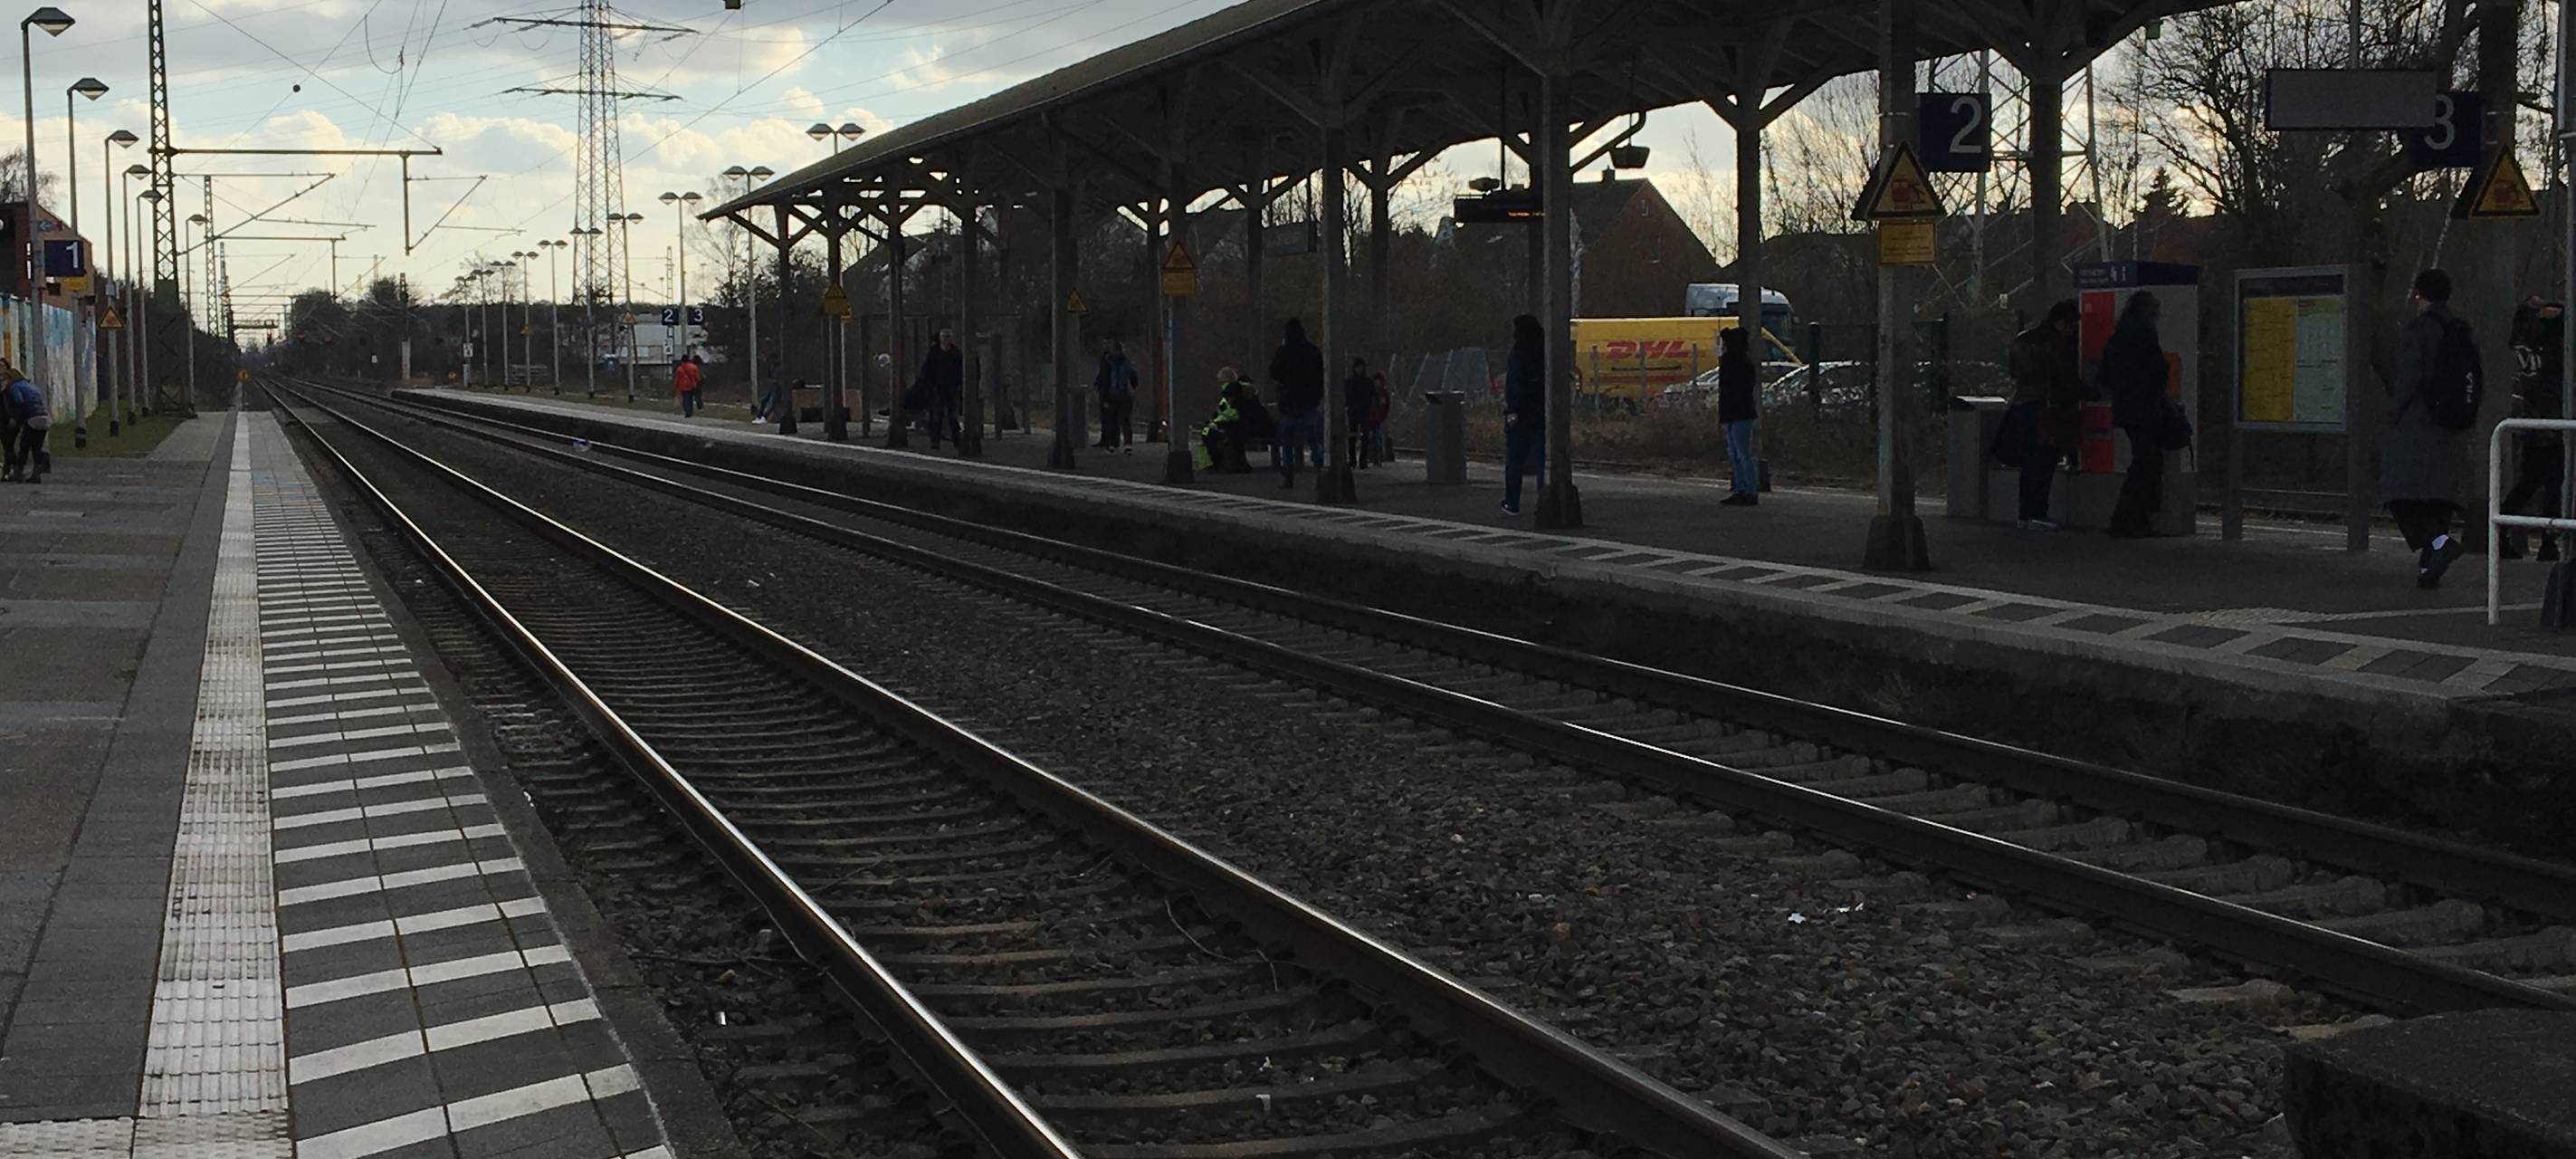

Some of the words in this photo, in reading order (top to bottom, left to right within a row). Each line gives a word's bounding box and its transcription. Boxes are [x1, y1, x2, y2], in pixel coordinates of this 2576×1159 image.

[1950, 97, 1982, 153] 2
[2424, 94, 2455, 150] 3
[66, 242, 78, 268] 1
[663, 309, 673, 322] 2
[694, 309, 703, 322] 3
[1607, 340, 1690, 359] DHL
